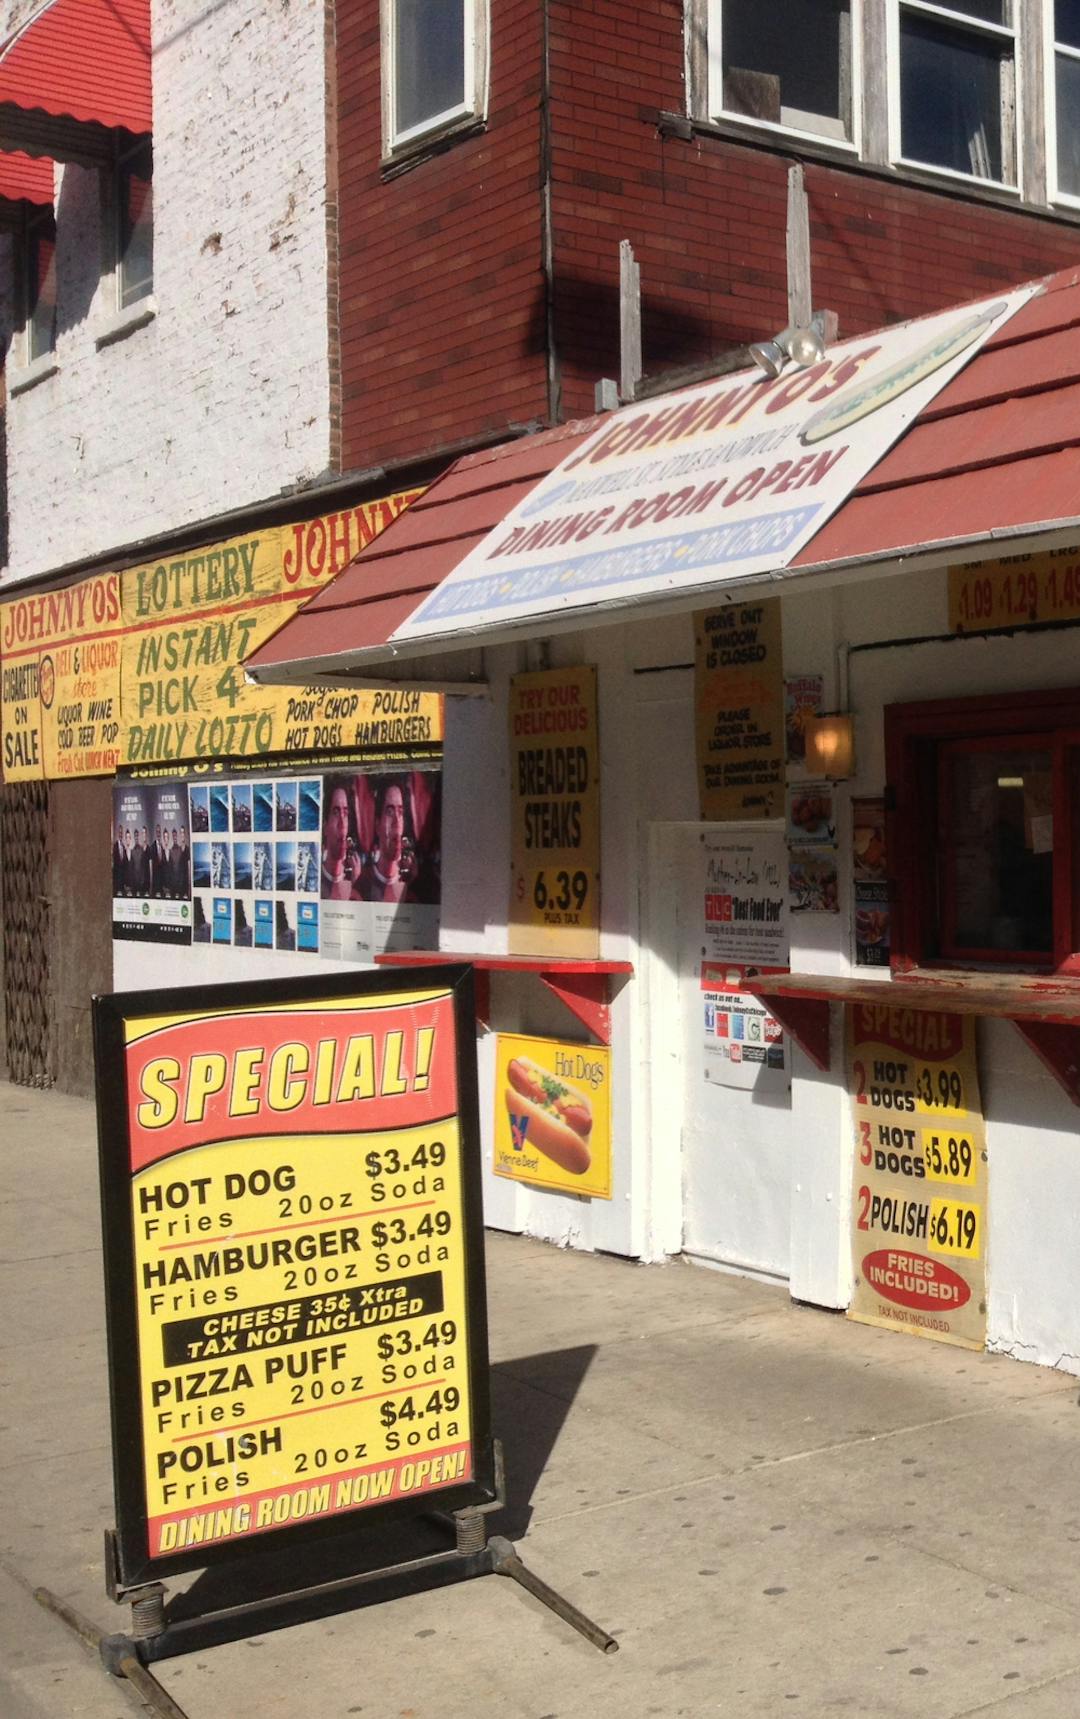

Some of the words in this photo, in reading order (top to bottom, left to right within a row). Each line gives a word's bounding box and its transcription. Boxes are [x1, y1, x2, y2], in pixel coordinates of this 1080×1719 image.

[486, 512, 614, 561] DINING
[602, 477, 730, 535] ROOM
[720, 445, 850, 508] OPEN
[136, 540, 260, 617] LOTTERY
[135, 619, 257, 676] INSTANT
[15, 708, 27, 725] ON
[88, 699, 113, 721] WINE
[139, 677, 198, 717] PICK
[216, 666, 241, 708] 4
[287, 699, 315, 723] PORK
[323, 695, 359, 719] CHOP
[372, 690, 420, 715] POLISH
[77, 725, 96, 746] BEER
[101, 722, 119, 744] POP
[127, 723, 188, 762] DAILY
[195, 713, 274, 756] LOTTO
[355, 716, 432, 745] HAMBURGERS
[514, 707, 589, 736] DELICIOUS
[5, 730, 39, 767] SALE
[518, 746, 588, 796] BREADED
[524, 801, 581, 849] STEAKS
[534, 870, 588, 910] 6.39
[137, 1027, 435, 1129] SPECIAL!
[555, 1052, 574, 1077] Hot
[576, 1055, 604, 1090] Dogs
[874, 1061, 907, 1084] HOT
[916, 1068, 962, 1109] $3.99
[870, 1086, 915, 1112] DOGS
[874, 1150, 926, 1178] DOGS
[878, 1125, 916, 1150] HOT
[926, 1136, 972, 1177] $5.89
[139, 1177, 212, 1214] HOT
[225, 1165, 296, 1201] DOG
[365, 1141, 446, 1179] $3.49
[144, 1212, 234, 1240] Fries
[280, 1192, 352, 1219] 20oz
[371, 1175, 445, 1203] Soda
[871, 1195, 929, 1239] POLISH
[930, 1207, 976, 1249] $6.19
[142, 1226, 361, 1290] HAMBURGER
[371, 1210, 451, 1248] $3.49
[888, 1253, 935, 1278] FRIES
[150, 1285, 238, 1316] Fries
[284, 1263, 357, 1291] 20oz
[376, 1247, 449, 1273] Soda
[870, 1266, 959, 1302] INCLUDED!
[187, 1338, 238, 1359] TAX
[247, 1325, 298, 1348] NOT
[306, 1298, 424, 1336] INCLUDED
[203, 1304, 301, 1337] CHEESE
[311, 1291, 350, 1314] 35¢
[361, 1284, 406, 1305] Xtra
[151, 1363, 254, 1408] PIZZA
[265, 1344, 347, 1384] PUFF
[377, 1319, 457, 1361] $3.49
[157, 1426, 282, 1479] POLISH
[380, 1386, 460, 1428] $4.49
[163, 1471, 250, 1505] Fries
[294, 1443, 368, 1474] 20oz
[386, 1419, 459, 1451] Soda
[159, 1503, 250, 1553] DINING
[256, 1484, 332, 1528] ROOM
[336, 1468, 395, 1508] NOW
[399, 1449, 466, 1491] OPEN!
